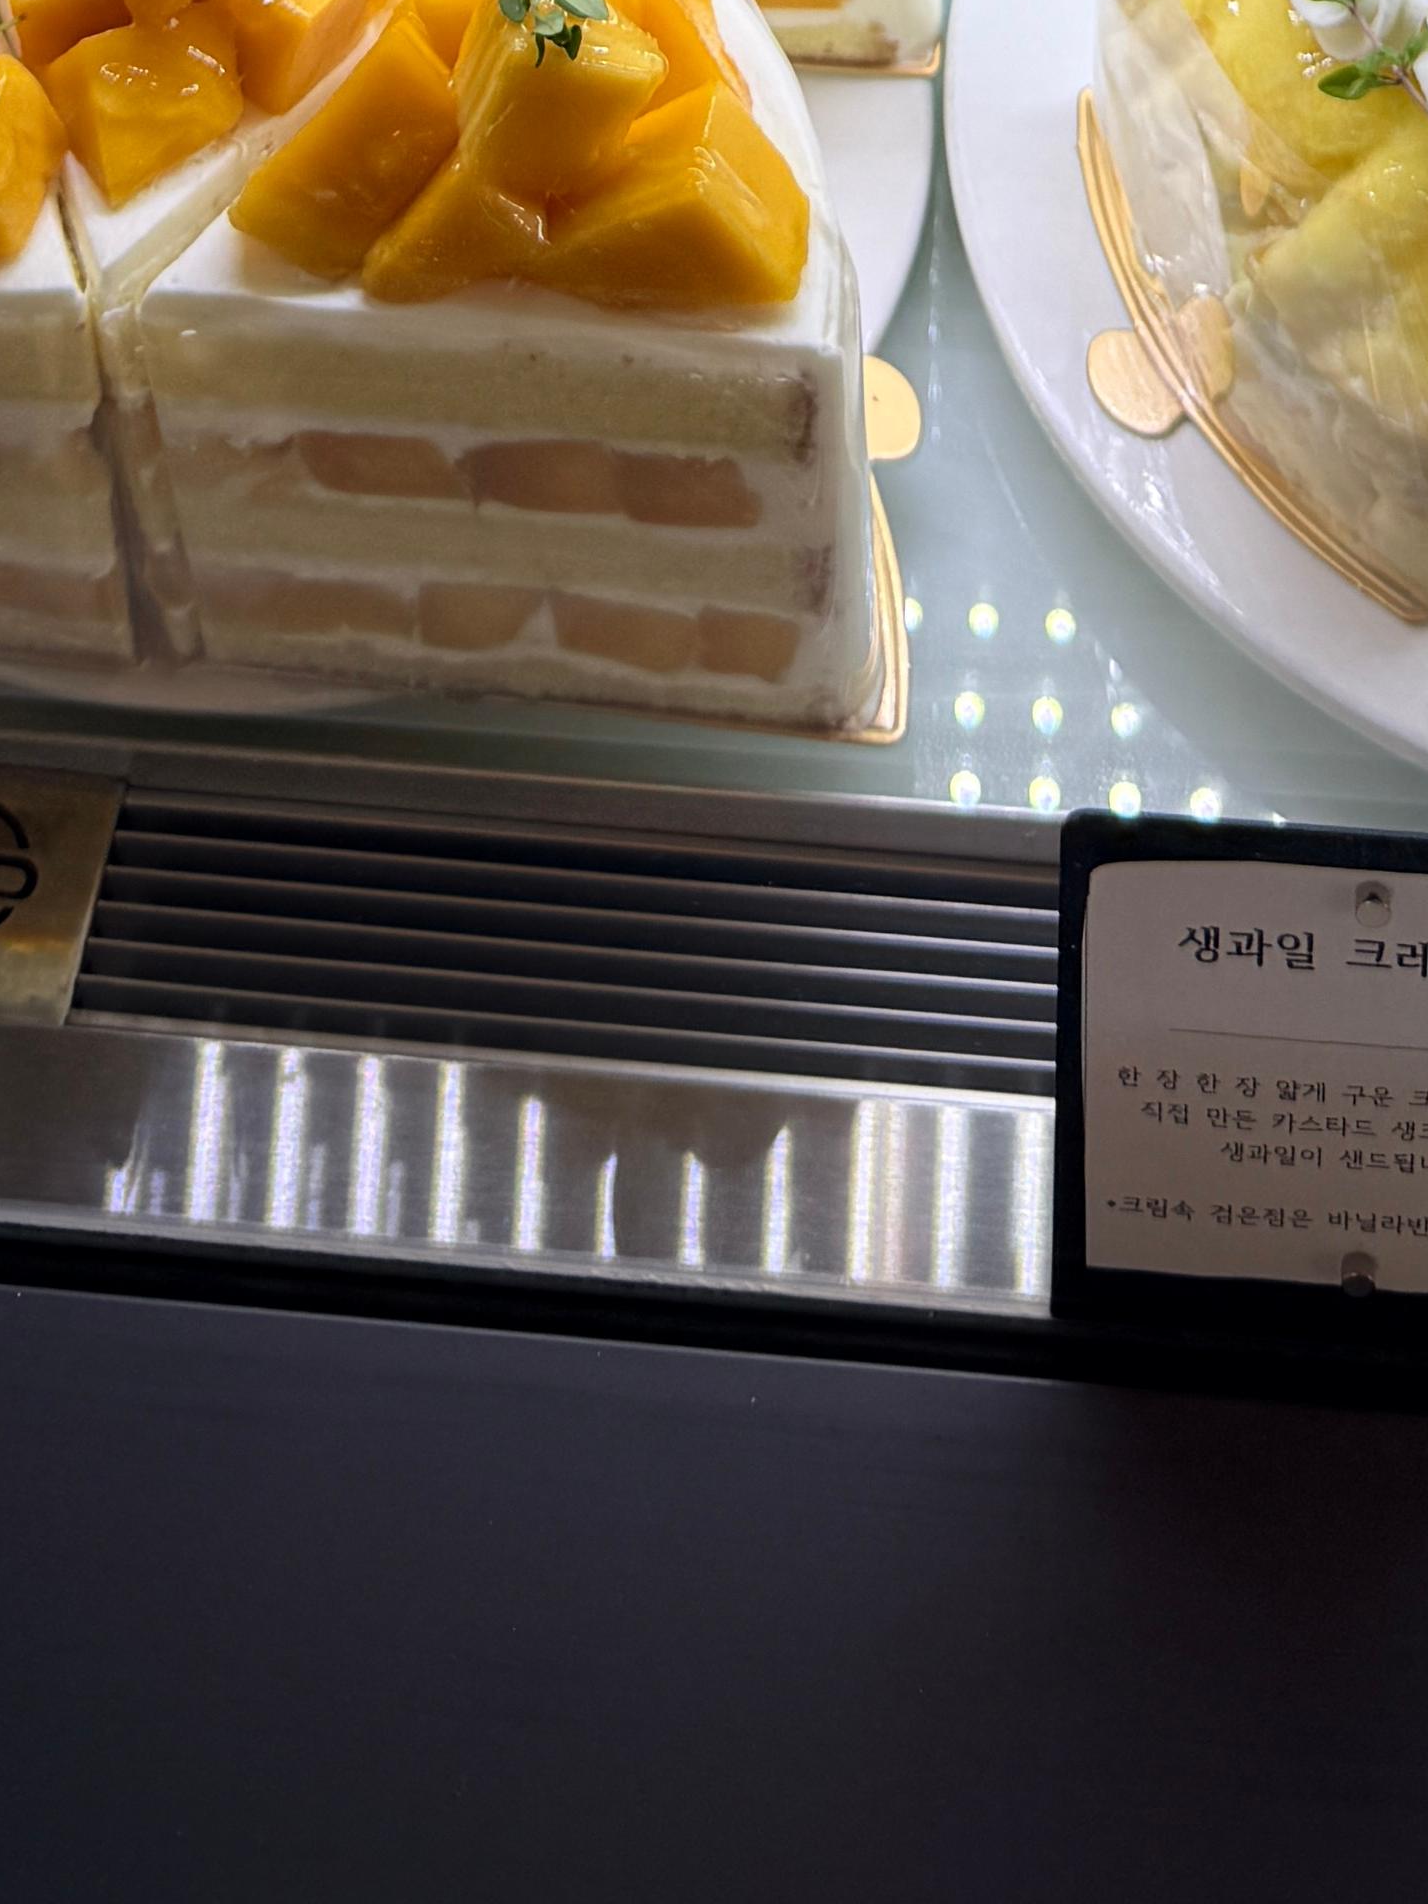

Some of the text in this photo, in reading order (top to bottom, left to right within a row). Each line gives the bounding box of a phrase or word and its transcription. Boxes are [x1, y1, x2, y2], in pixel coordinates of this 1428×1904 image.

[1178, 925, 1315, 971] 생과일
[1117, 1065, 1141, 1088] 한
[1156, 1069, 1180, 1091] 장
[1196, 1072, 1221, 1095] 한
[1235, 1076, 1261, 1099] 장
[1275, 1079, 1326, 1104] 얇게
[1342, 1084, 1394, 1109] 구운
[1140, 1101, 1189, 1126] 직접
[1206, 1106, 1258, 1132] 만든
[1272, 1112, 1377, 1138] 카스타드
[1220, 1141, 1323, 1169] 생과일이
